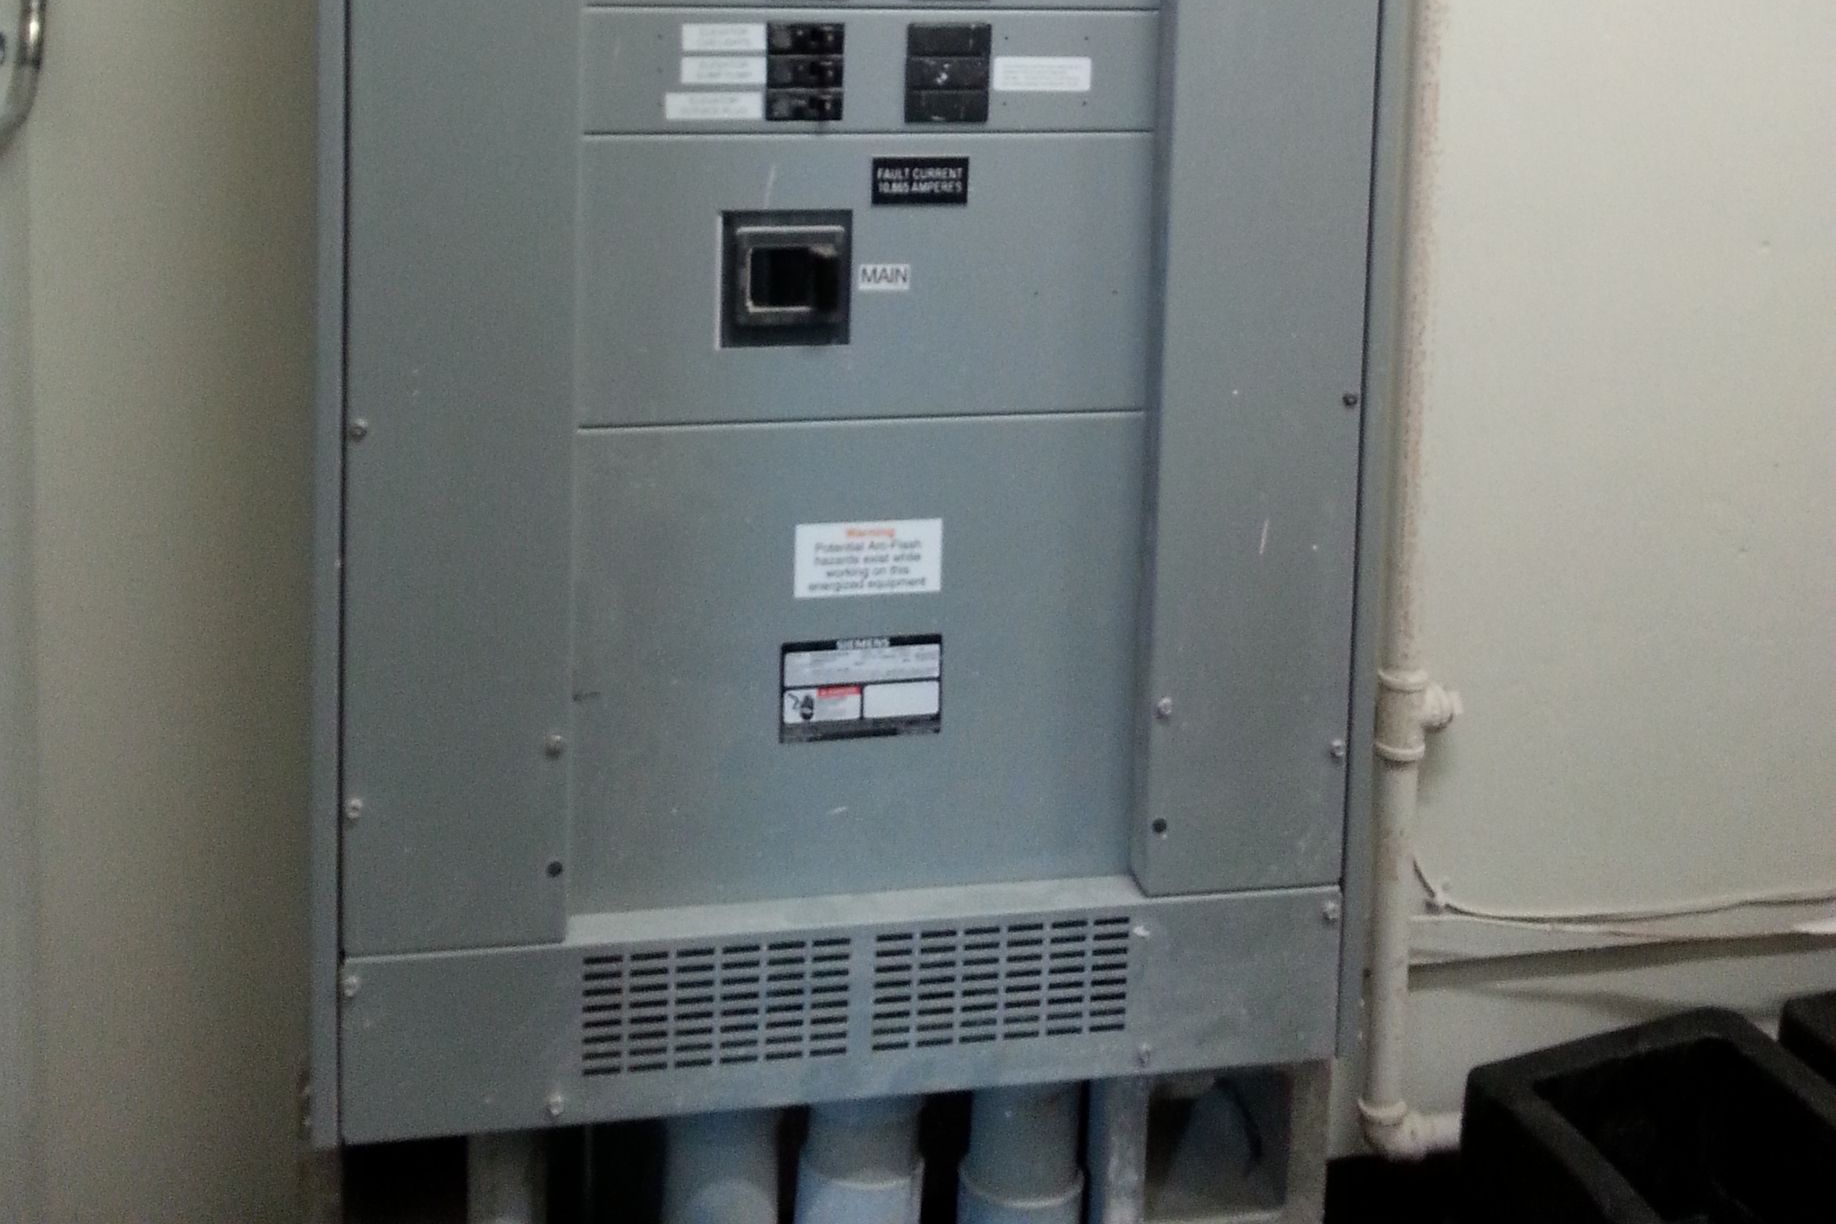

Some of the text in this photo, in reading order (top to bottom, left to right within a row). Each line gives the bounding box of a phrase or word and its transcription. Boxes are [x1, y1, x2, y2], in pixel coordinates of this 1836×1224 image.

[876, 167, 963, 180] FAULT CURRENT
[911, 180, 963, 193] AMPERES
[860, 267, 908, 284] MAIN
[814, 541, 865, 553] Potential
[813, 555, 859, 566] hazards
[826, 567, 870, 580] working
[808, 576, 927, 592] energized equipment
